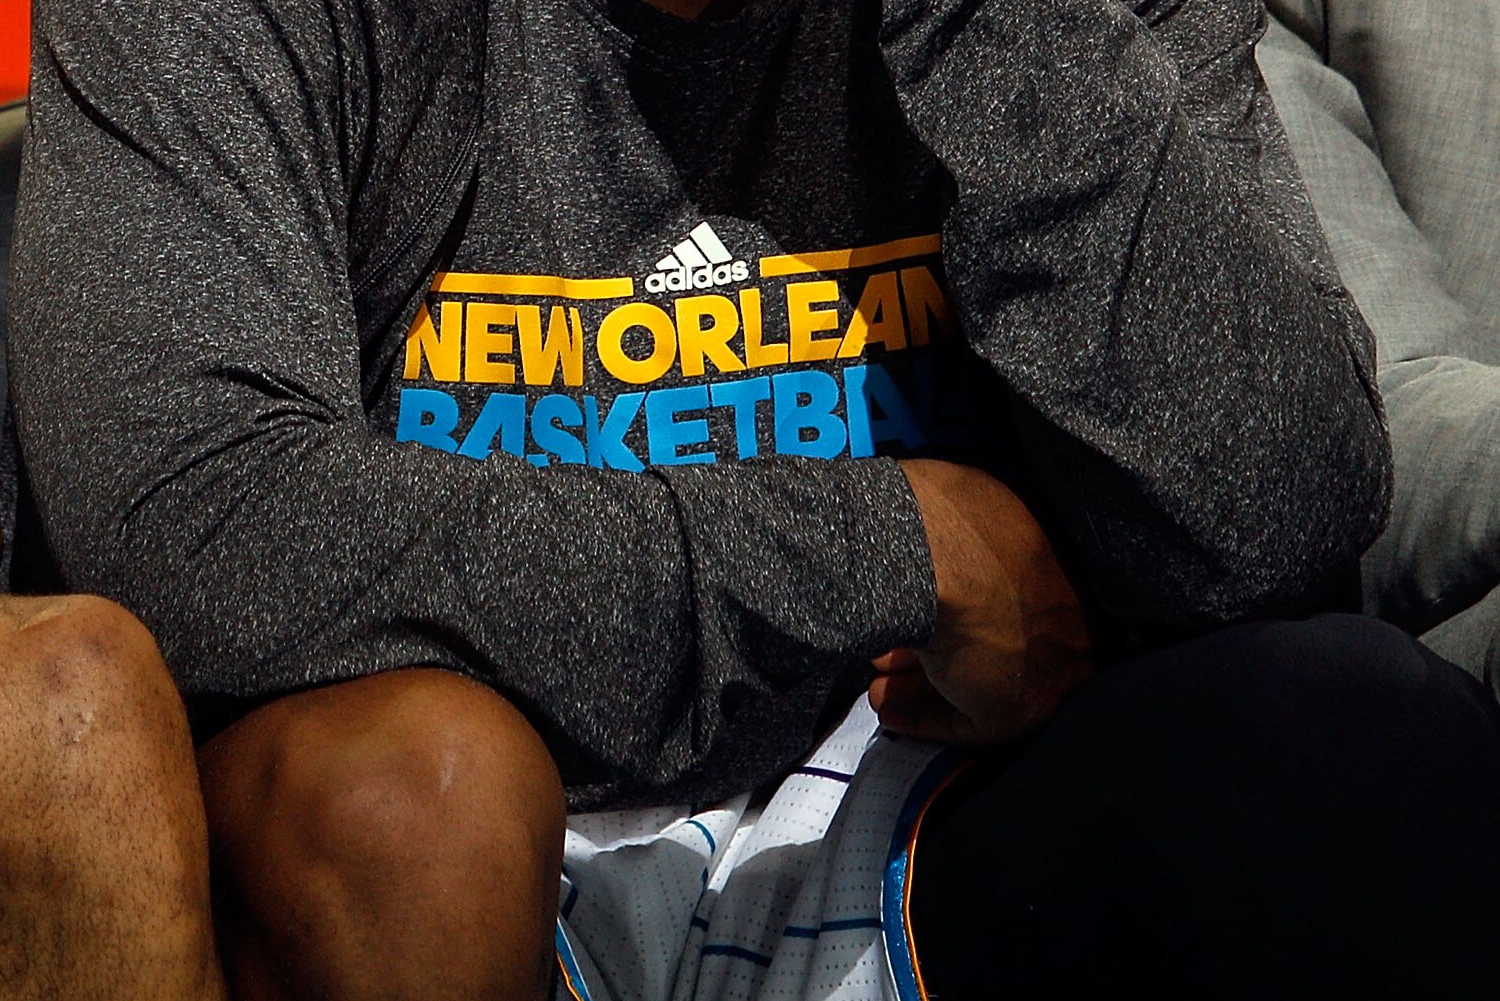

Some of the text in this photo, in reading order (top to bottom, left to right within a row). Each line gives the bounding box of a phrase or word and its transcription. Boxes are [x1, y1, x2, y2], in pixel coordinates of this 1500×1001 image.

[644, 258, 750, 294] adidas
[403, 299, 584, 387] NEW
[396, 362, 932, 474] BASKETBA
